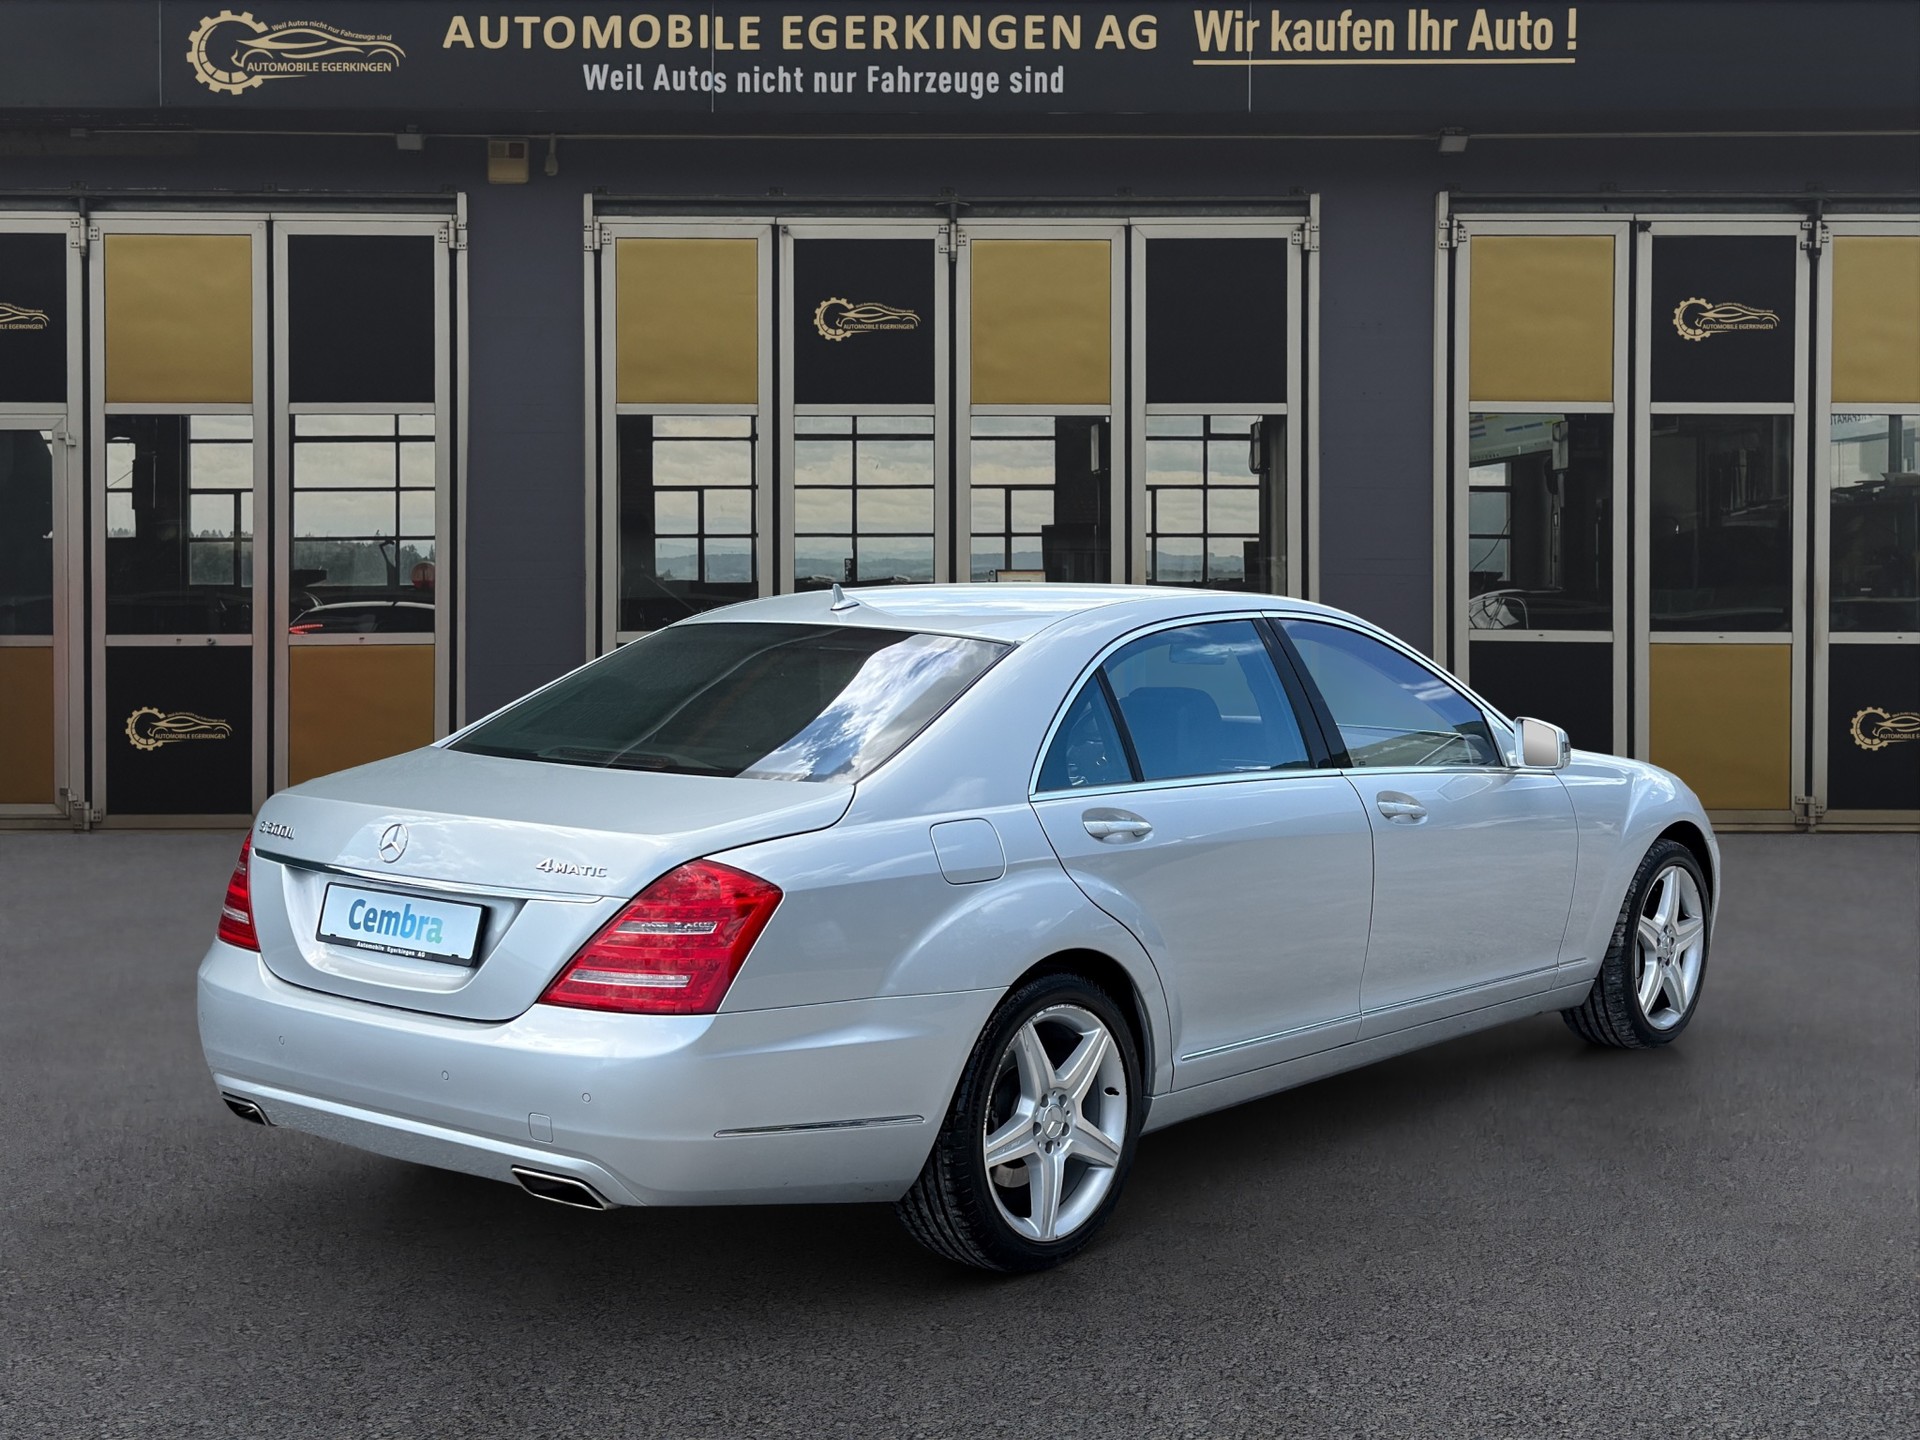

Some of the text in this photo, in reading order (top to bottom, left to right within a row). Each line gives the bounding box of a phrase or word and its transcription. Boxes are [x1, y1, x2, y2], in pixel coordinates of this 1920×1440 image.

[270, 22, 287, 31] Weil
[288, 20, 309, 28] Autos
[309, 20, 328, 31] nicht
[328, 26, 340, 35] nur
[340, 29, 376, 42] Fahrzeuge
[443, 14, 1158, 51] AUTOMOBILE EGERKINGEN AG
[1193, 9, 1260, 51] Wir
[1270, 9, 1395, 52] kaufen
[1407, 8, 1459, 51] Ihr
[1466, 8, 1554, 51] Auto
[246, 62, 392, 72] AUTOMOBILE EGERKINGEN
[583, 64, 1064, 100] Weil Autos nicht nur Fahrzeuge sind
[536, 857, 608, 878] 4MATIC
[348, 898, 444, 944] Cembra
